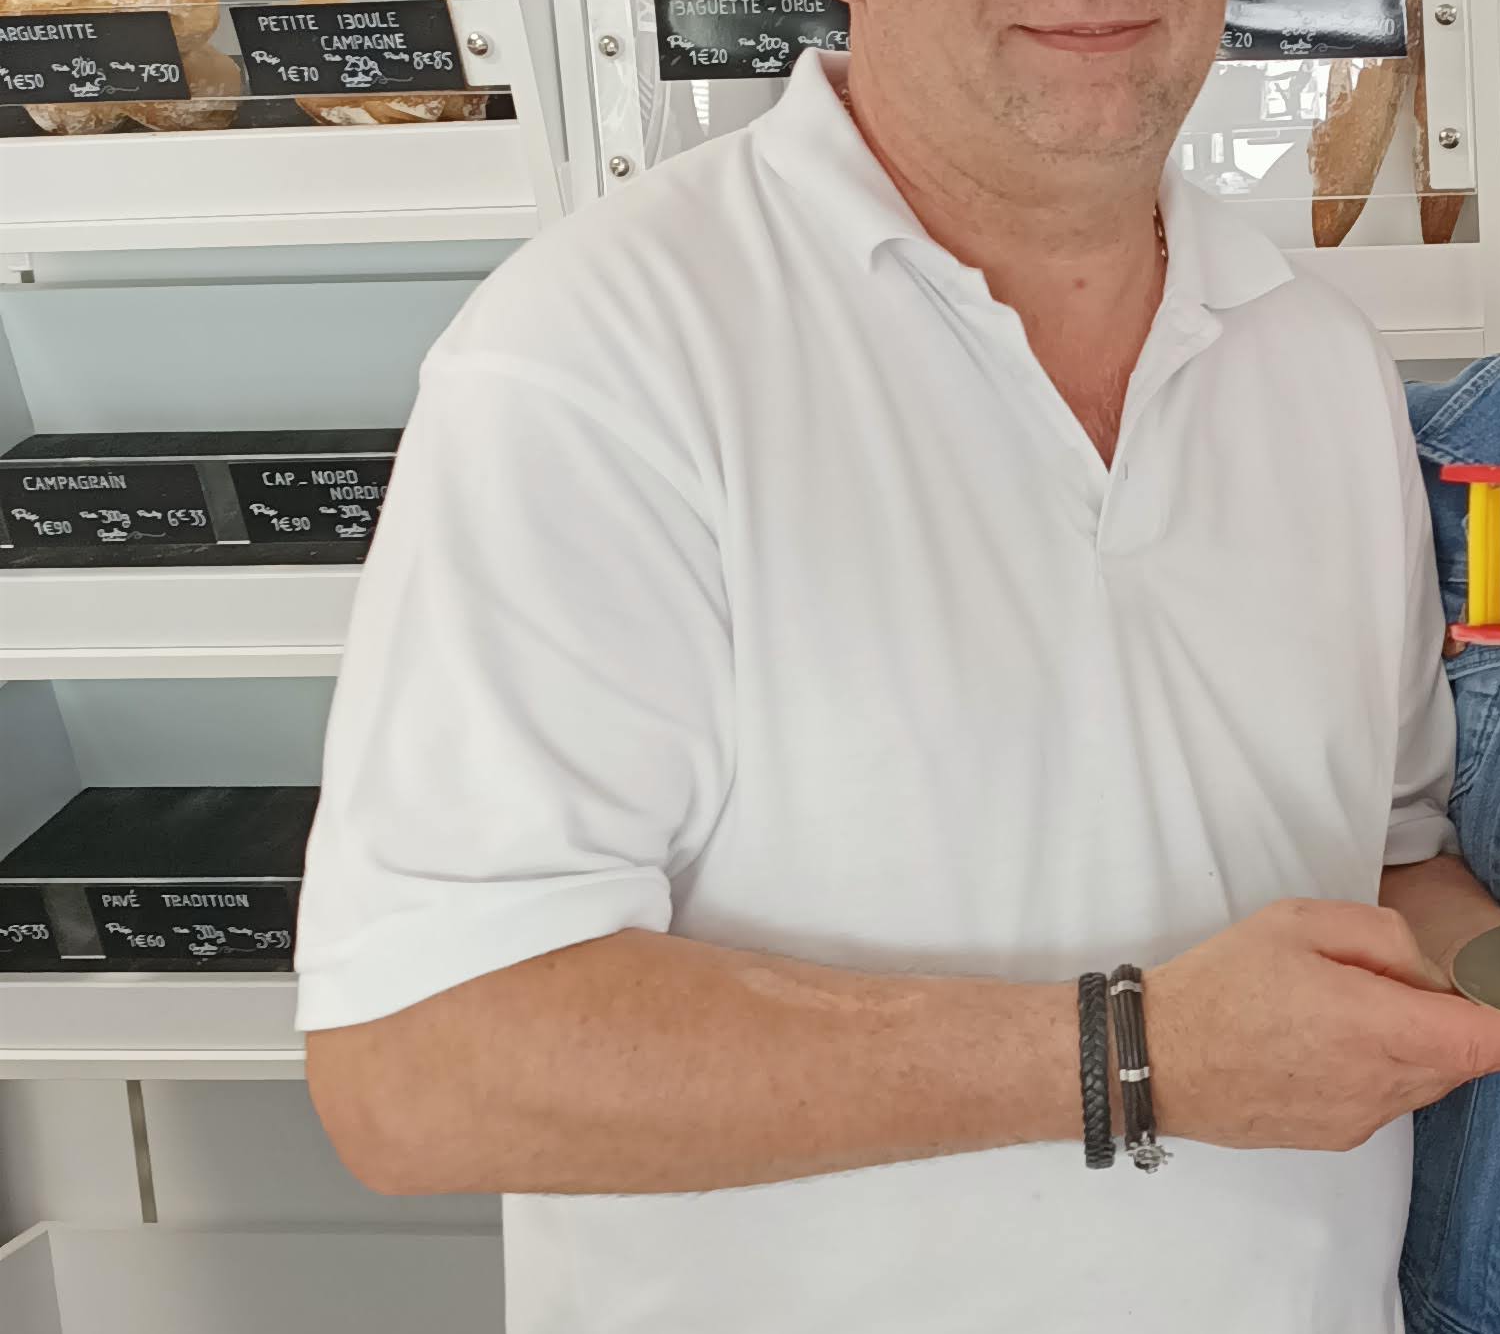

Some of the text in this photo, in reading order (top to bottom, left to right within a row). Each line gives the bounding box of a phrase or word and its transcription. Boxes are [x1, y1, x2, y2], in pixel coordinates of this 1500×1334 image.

[257, 11, 400, 32] PETITE BOULE
[0, 23, 98, 42] ARGUERITTE
[1221, 32, 1253, 48] €20
[320, 33, 407, 51] CAMPAGNE
[412, 50, 454, 71] 8€85
[689, 48, 728, 66] 1€20
[3, 73, 45, 90] 1€50
[138, 63, 180, 83] 7€50
[277, 66, 319, 83] 1€70
[22, 471, 127, 491] CAMPAGRAIN
[33, 521, 72, 536] 1€90
[270, 516, 311, 532] 1€90
[102, 889, 250, 908] PAVÉ TRADITION
[127, 934, 166, 948] 1€60
